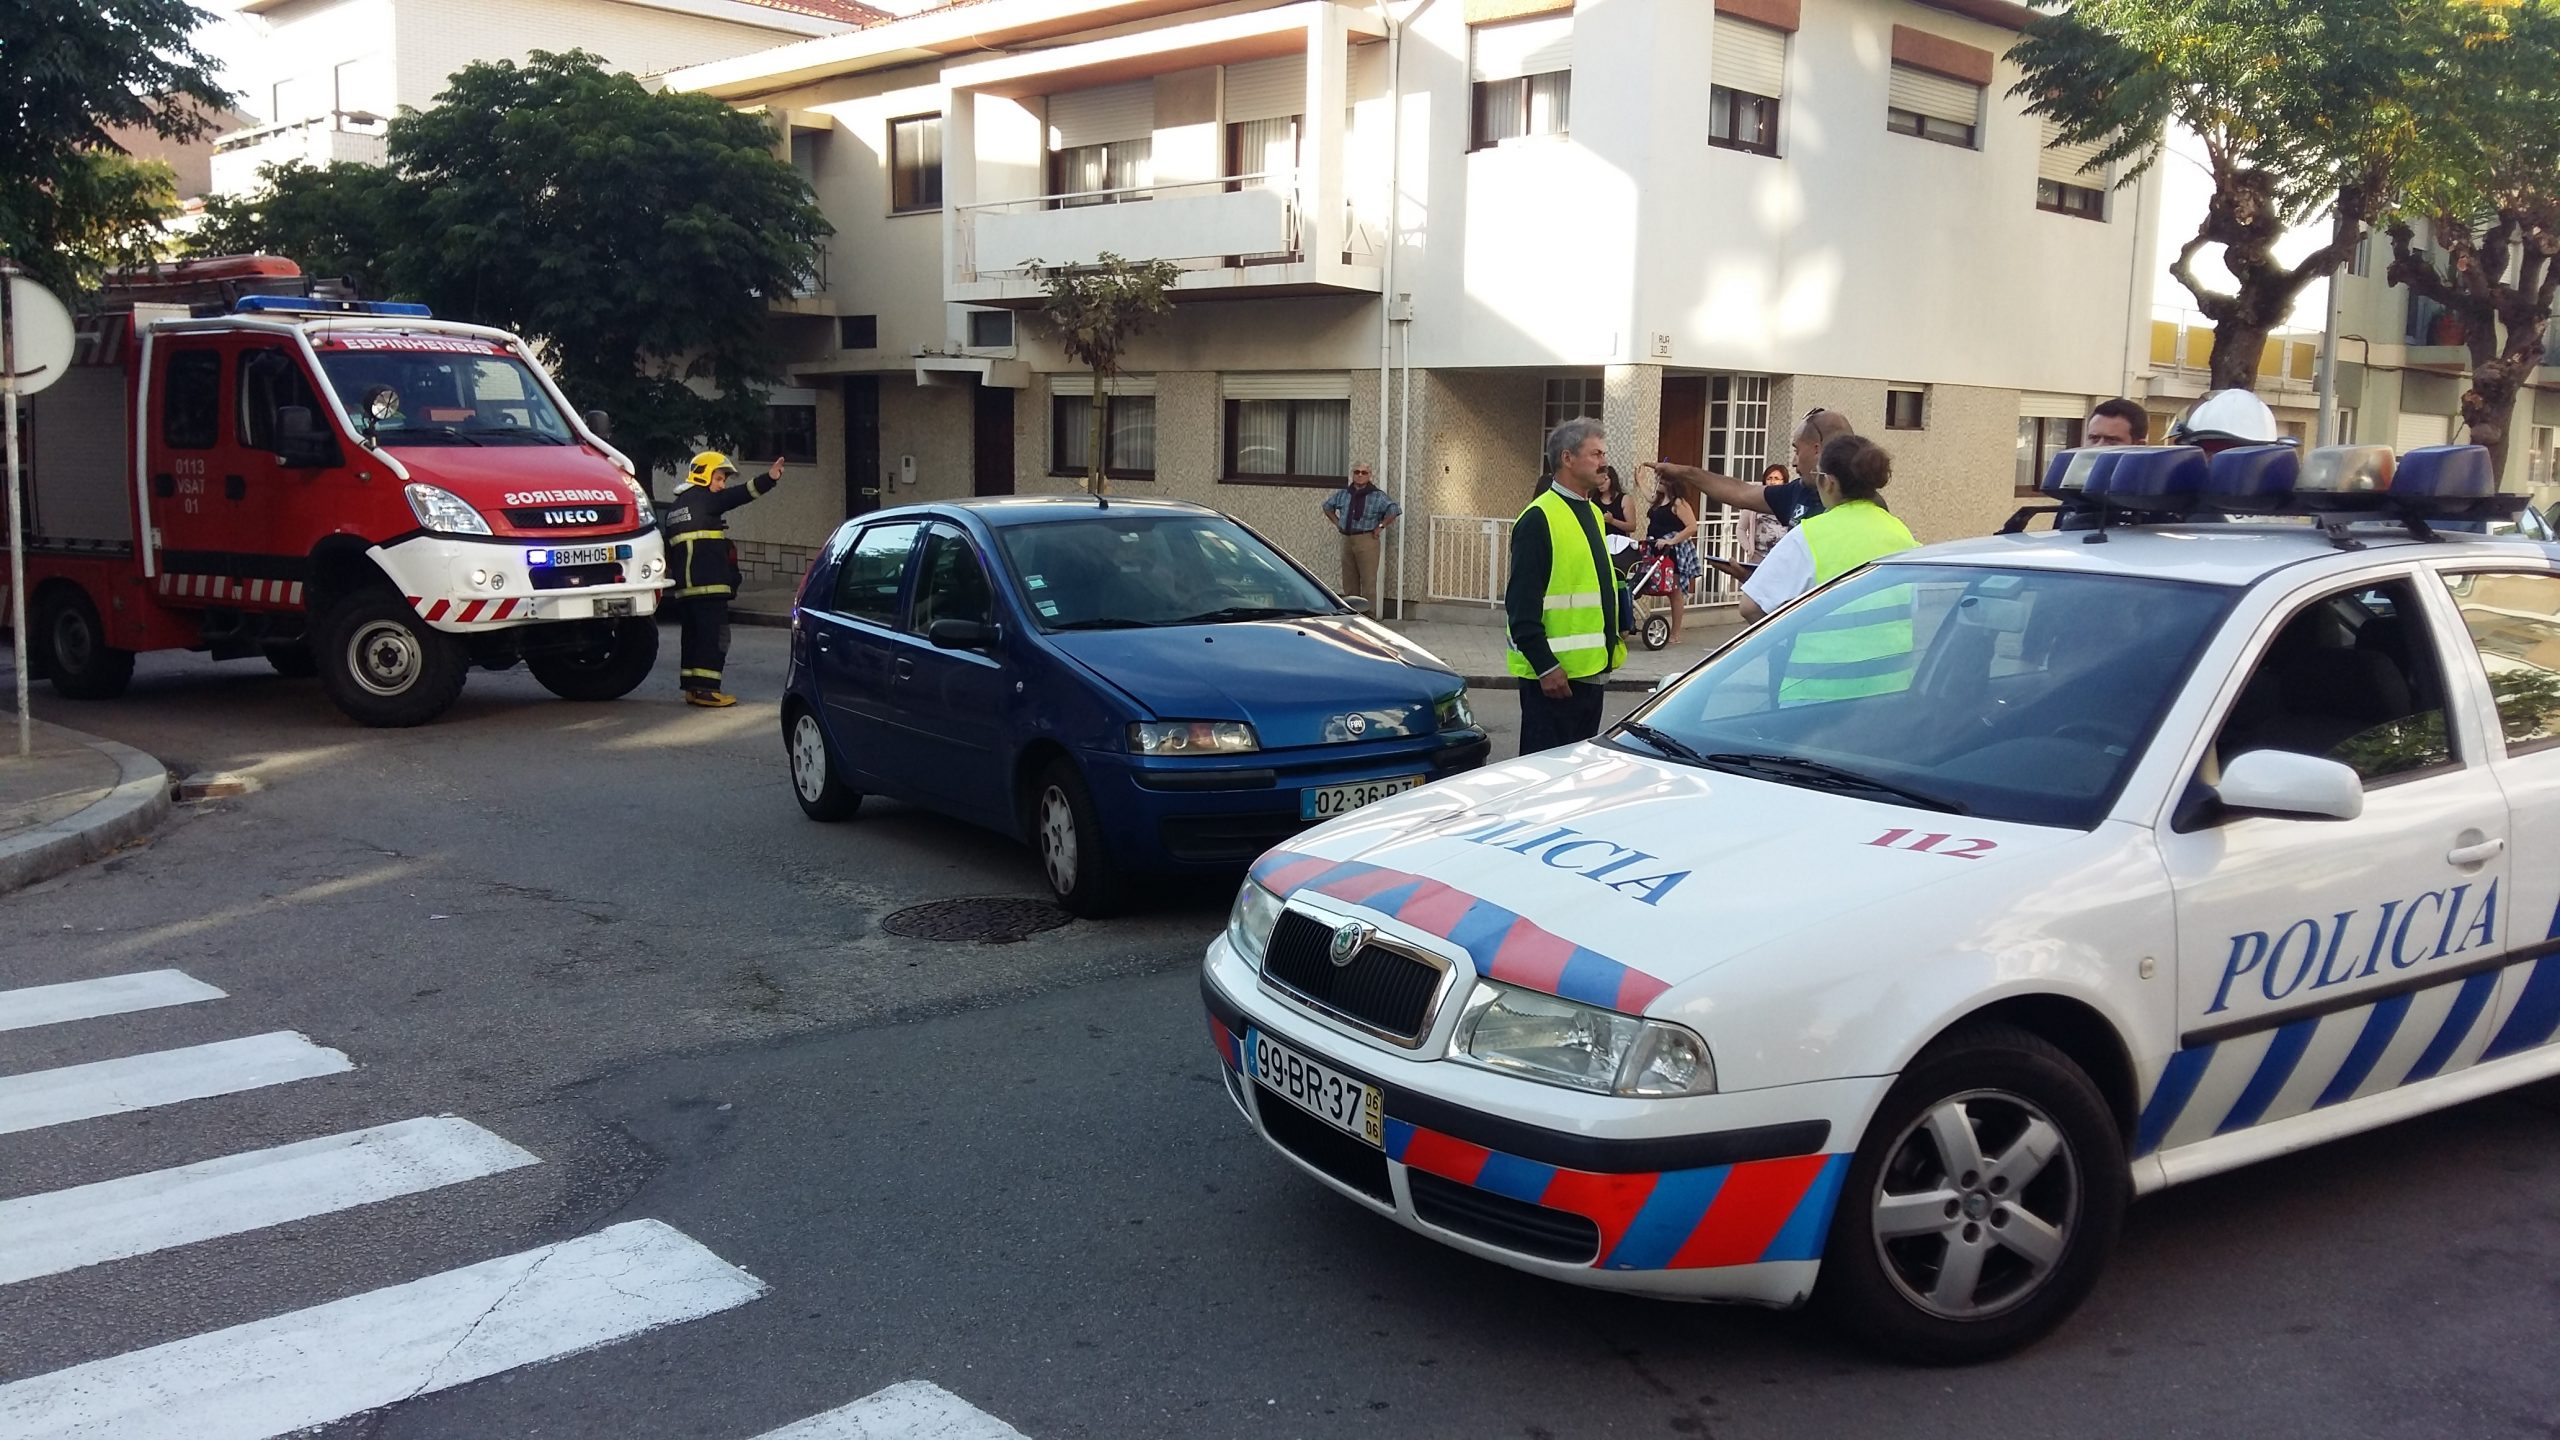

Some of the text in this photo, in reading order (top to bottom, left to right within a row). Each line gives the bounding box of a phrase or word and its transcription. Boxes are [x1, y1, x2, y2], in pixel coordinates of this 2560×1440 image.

[342, 338, 494, 355] ESPINHENSES
[1658, 334, 1670, 344] RUA
[175, 458, 205, 475] 0113
[176, 478, 205, 495] VSAT
[184, 497, 199, 515] 01
[544, 509, 599, 525] IVECO
[1859, 828, 1998, 860] 112
[2203, 876, 2498, 1016] POLICIA
[1365, 1091, 1379, 1111] 06
[1365, 1119, 1379, 1138] 06
